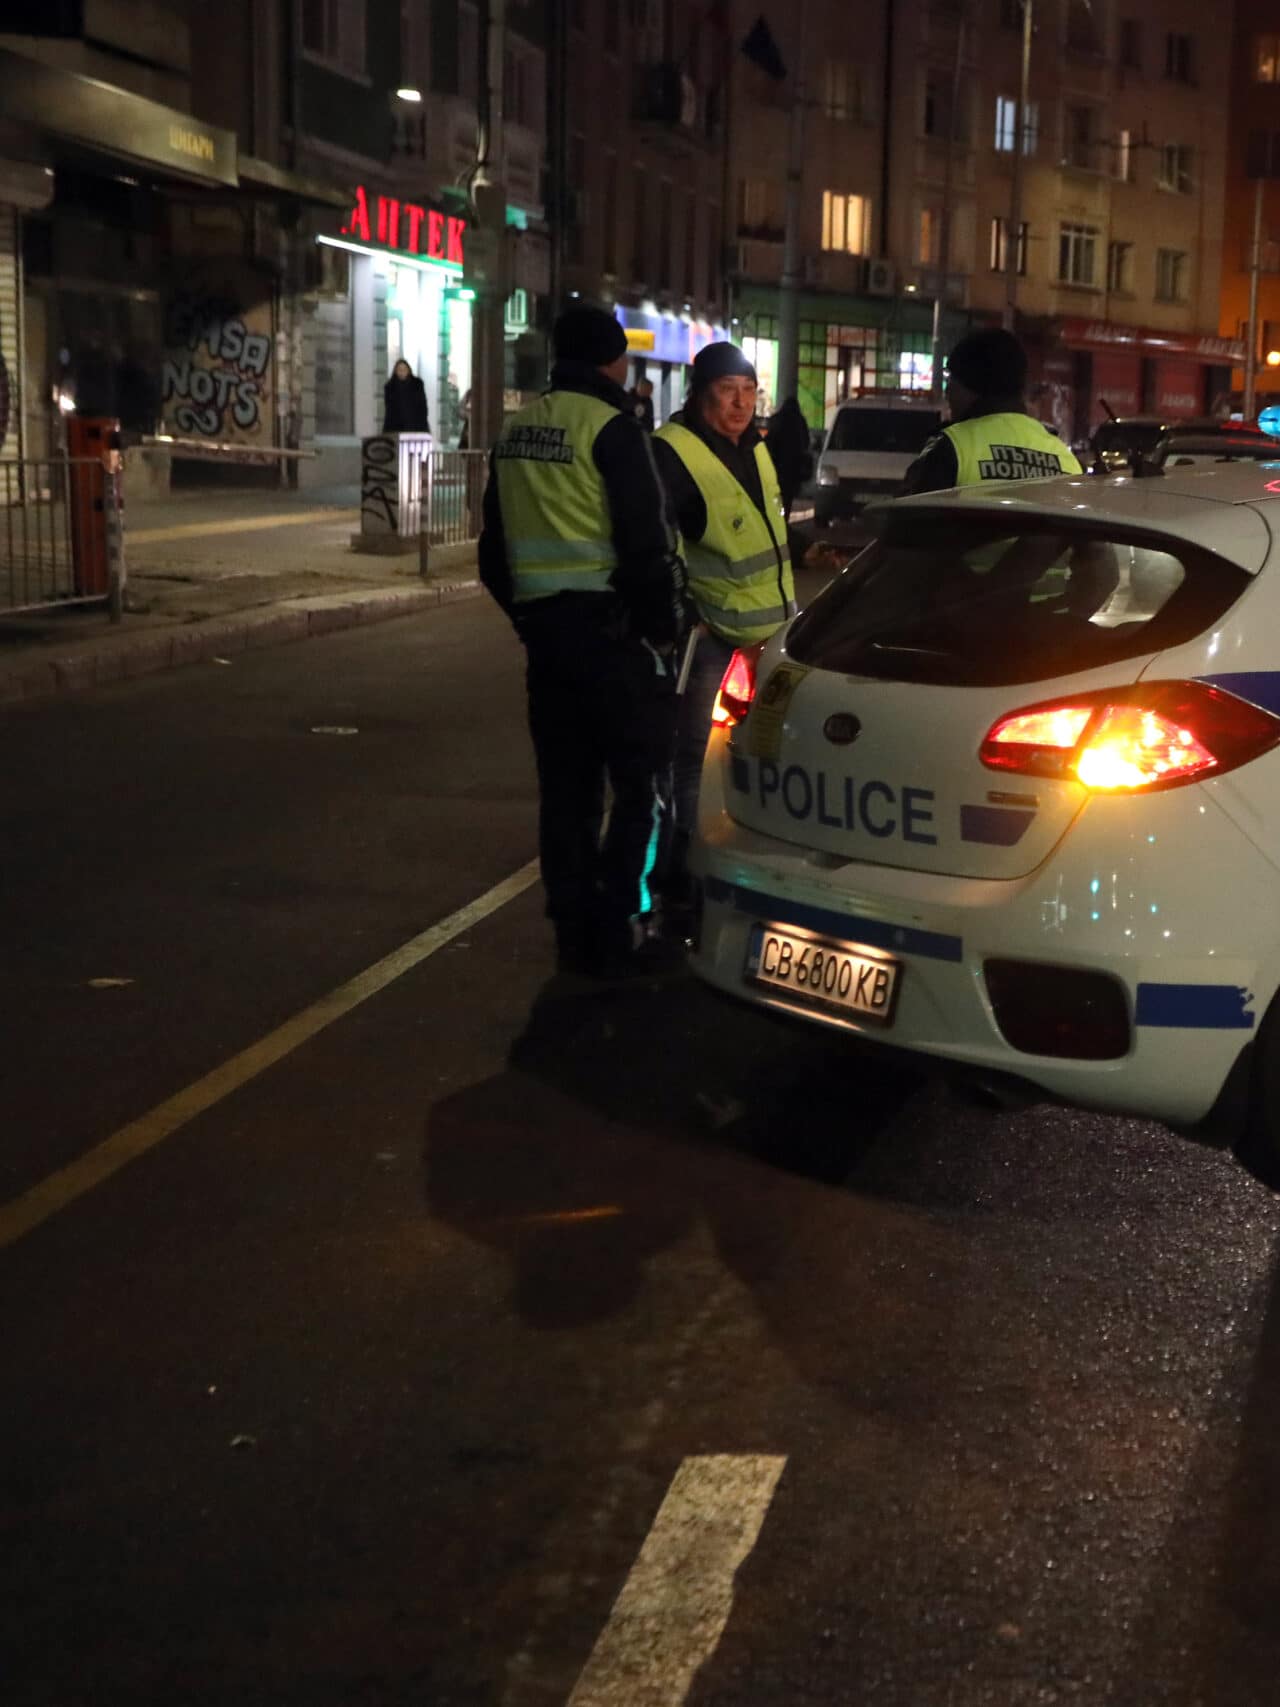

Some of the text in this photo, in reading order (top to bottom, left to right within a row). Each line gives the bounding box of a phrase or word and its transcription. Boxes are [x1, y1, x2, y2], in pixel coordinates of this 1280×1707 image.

[341, 184, 467, 265] АПТЕК
[980, 461, 1059, 479] ПОЛИЦ
[992, 446, 1060, 471] ПЪТНА
[758, 759, 938, 846] POLICE
